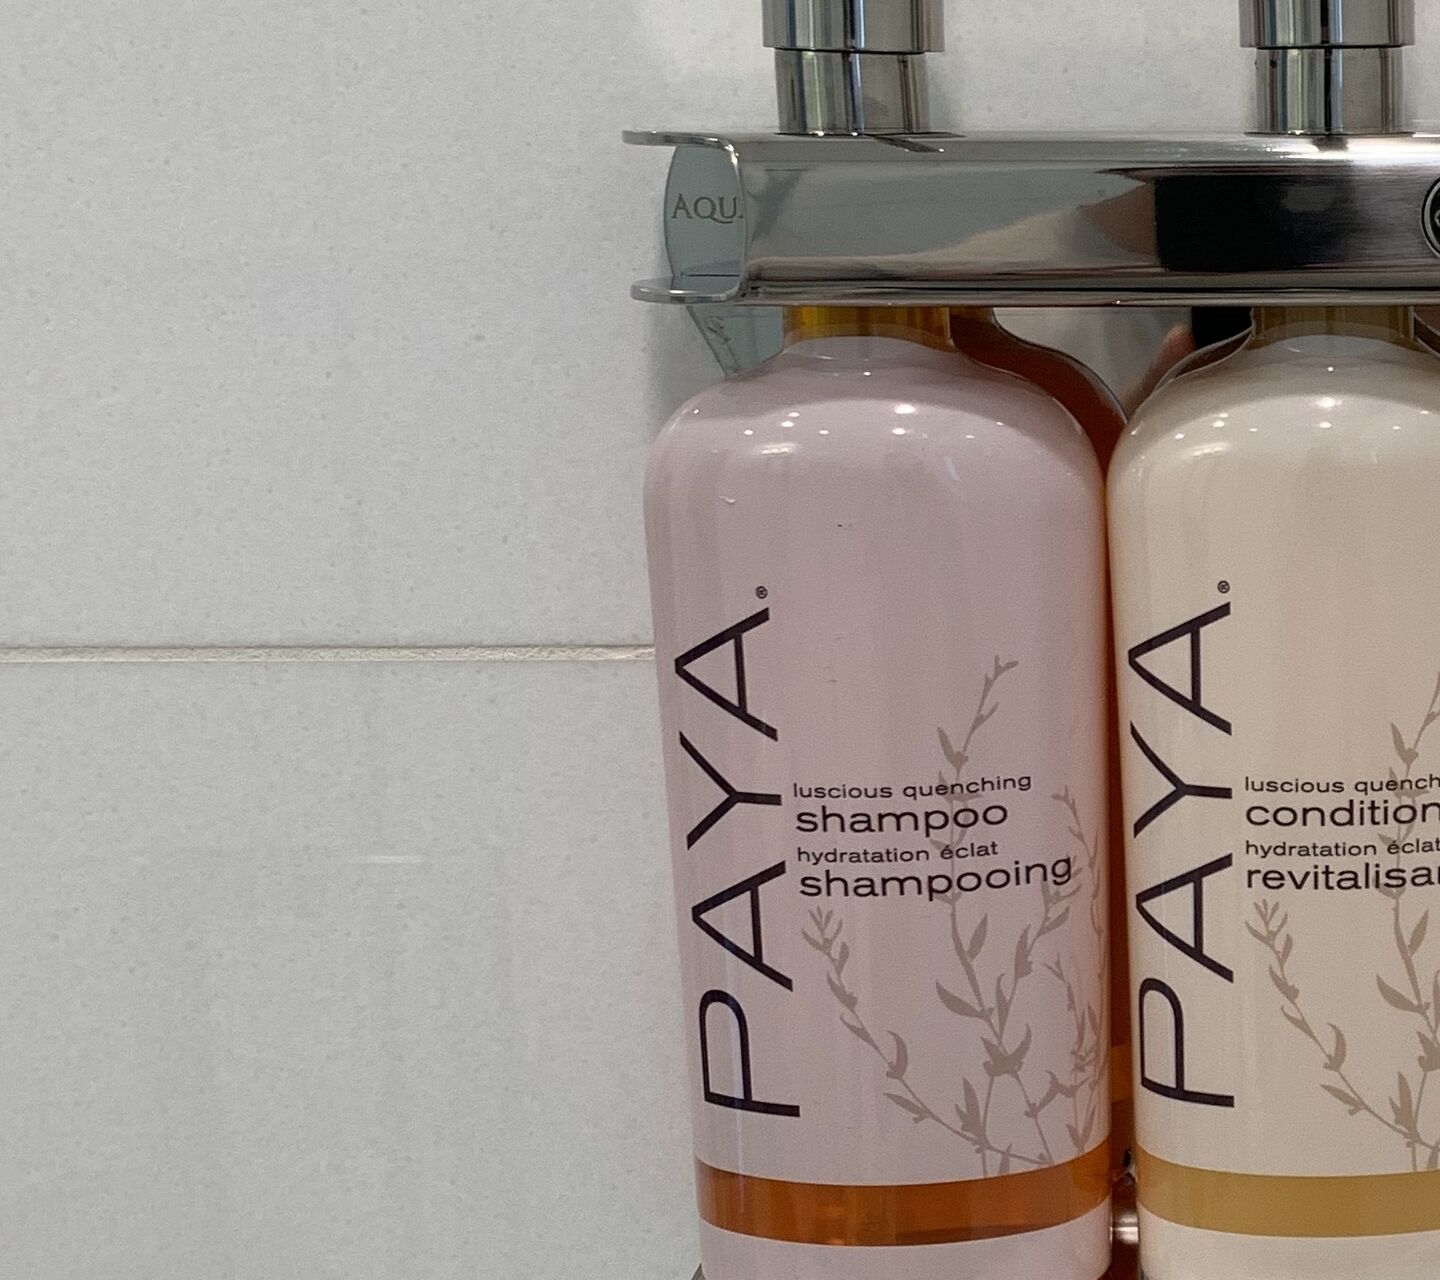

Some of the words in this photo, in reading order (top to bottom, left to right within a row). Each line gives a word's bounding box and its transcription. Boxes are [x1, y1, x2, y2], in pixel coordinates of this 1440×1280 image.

[671, 193, 744, 224] AQU
[793, 782, 893, 799] luscious
[901, 774, 1033, 799] quenching
[1245, 776, 1345, 793] luscious
[795, 804, 1009, 838] shampoo
[797, 846, 930, 866] hydratation
[940, 841, 998, 860] éclat
[1245, 839, 1377, 859] hydratation
[798, 856, 1073, 902] shampooing
